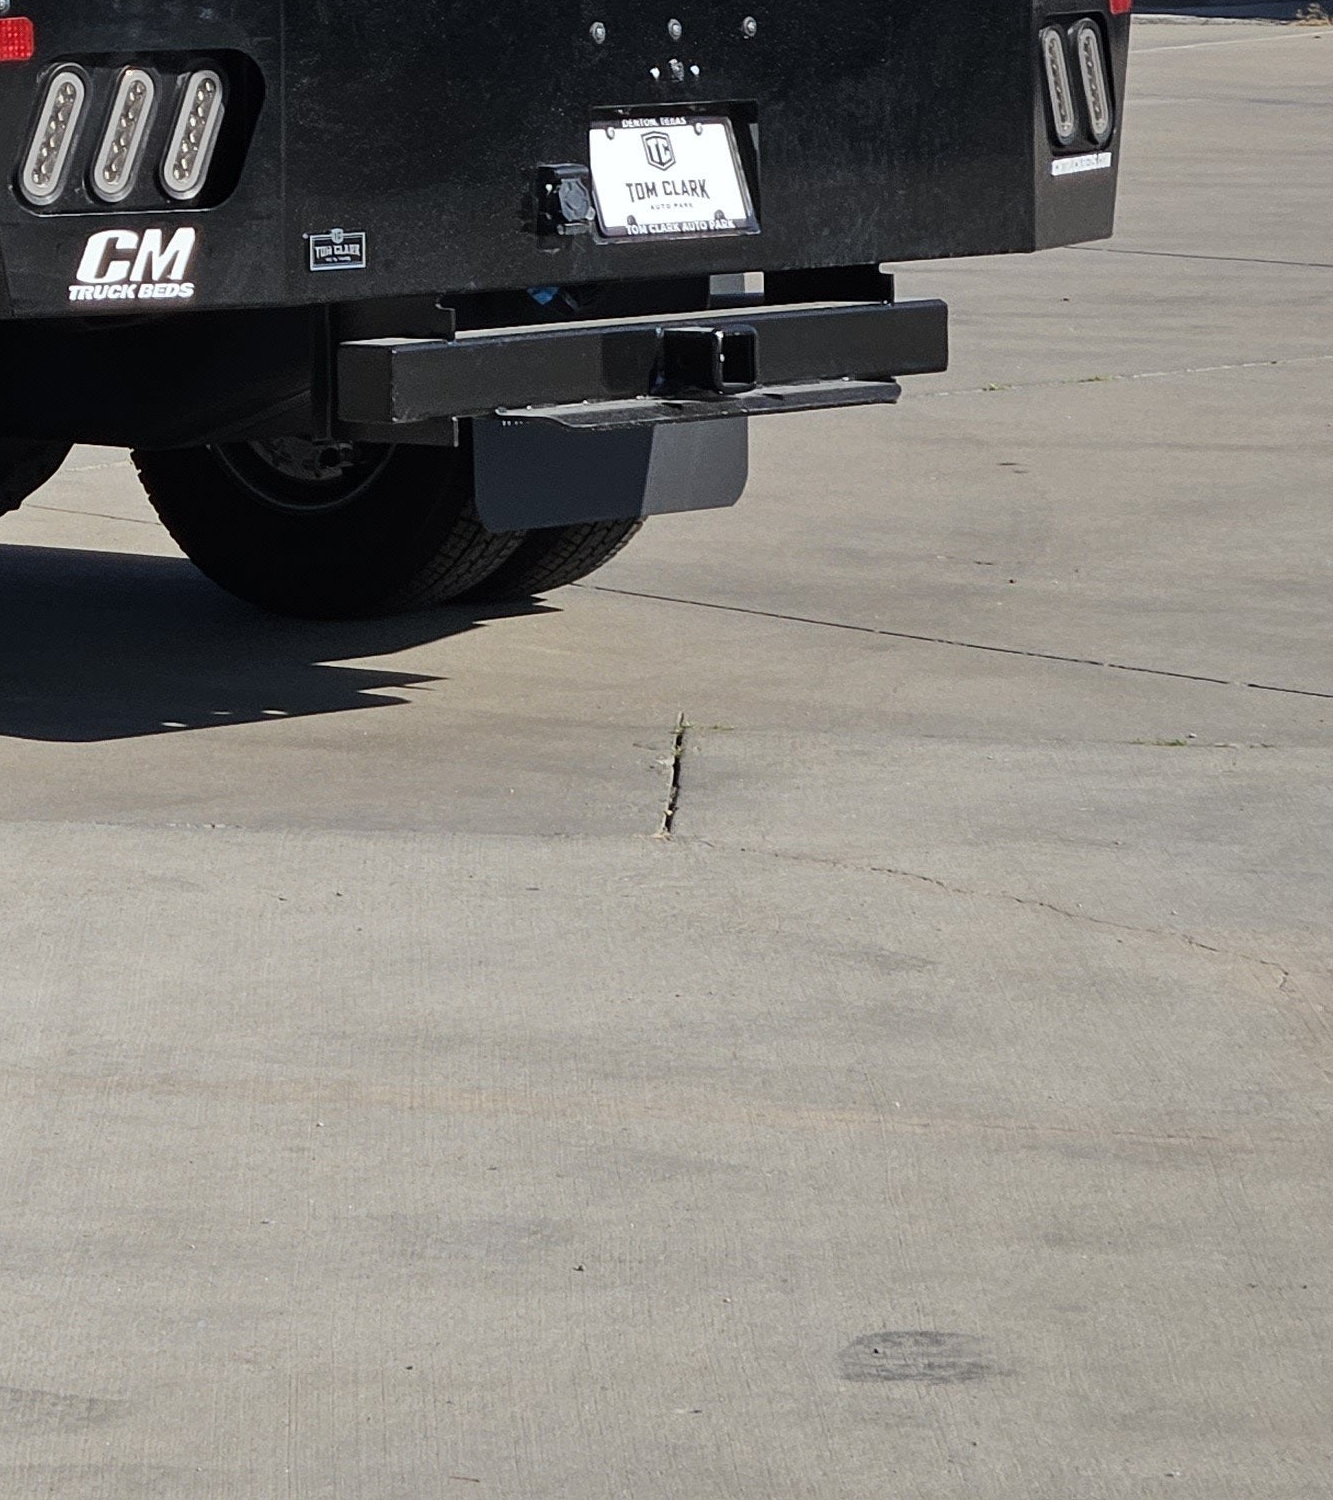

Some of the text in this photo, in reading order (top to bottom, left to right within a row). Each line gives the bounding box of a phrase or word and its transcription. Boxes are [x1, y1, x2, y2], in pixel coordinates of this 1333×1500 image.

[626, 179, 710, 203] TOM CLARK
[626, 219, 735, 235] TOM CLARK AUTO PARK
[76, 227, 196, 284] CM
[68, 282, 195, 300] TRUCK BEDS
